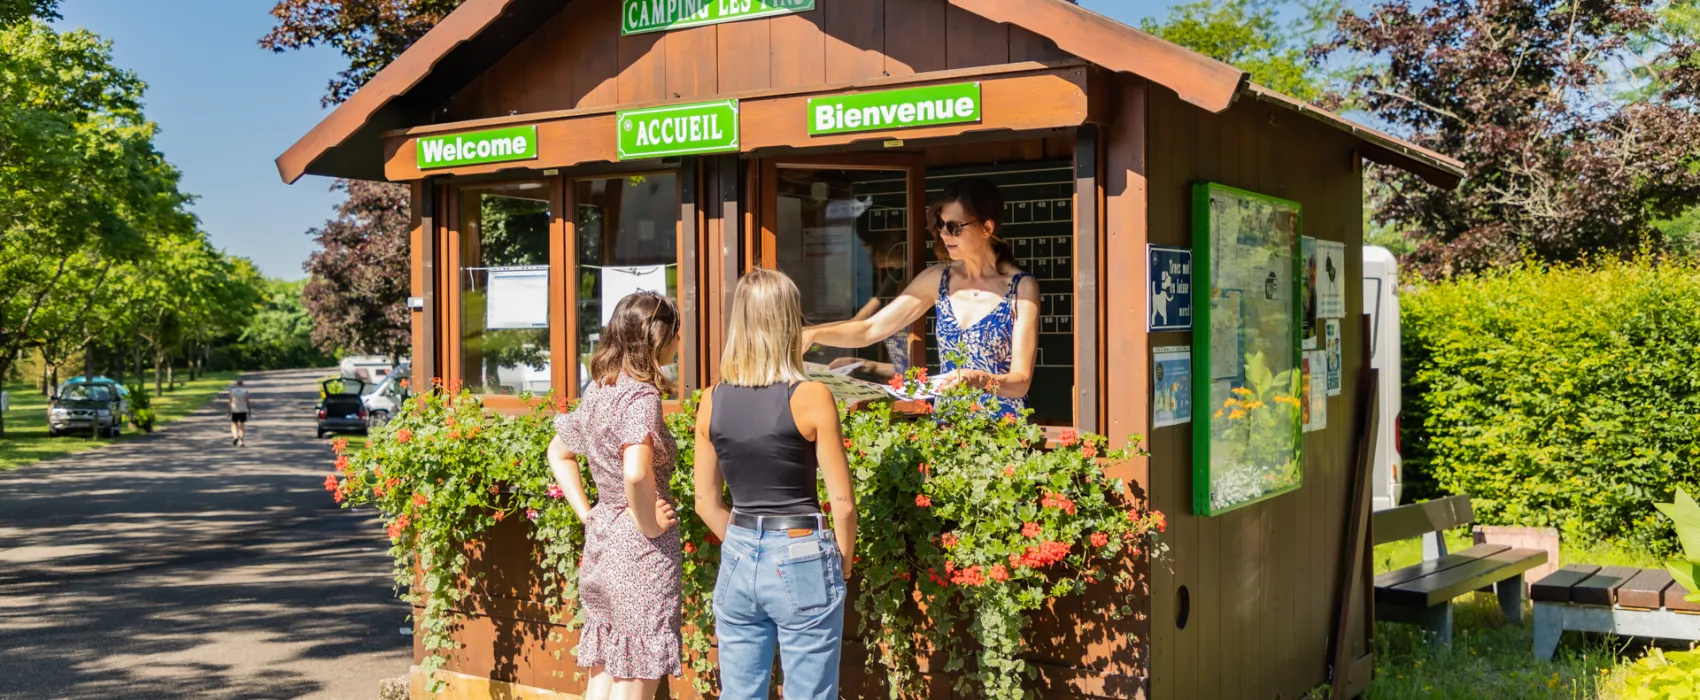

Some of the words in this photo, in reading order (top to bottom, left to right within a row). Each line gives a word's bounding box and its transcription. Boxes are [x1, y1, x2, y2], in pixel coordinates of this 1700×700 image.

[628, 0, 709, 28] CAMPING
[815, 96, 974, 130] Bienvenue
[635, 113, 722, 146] ACCUEIL
[422, 135, 527, 163] Welcome
